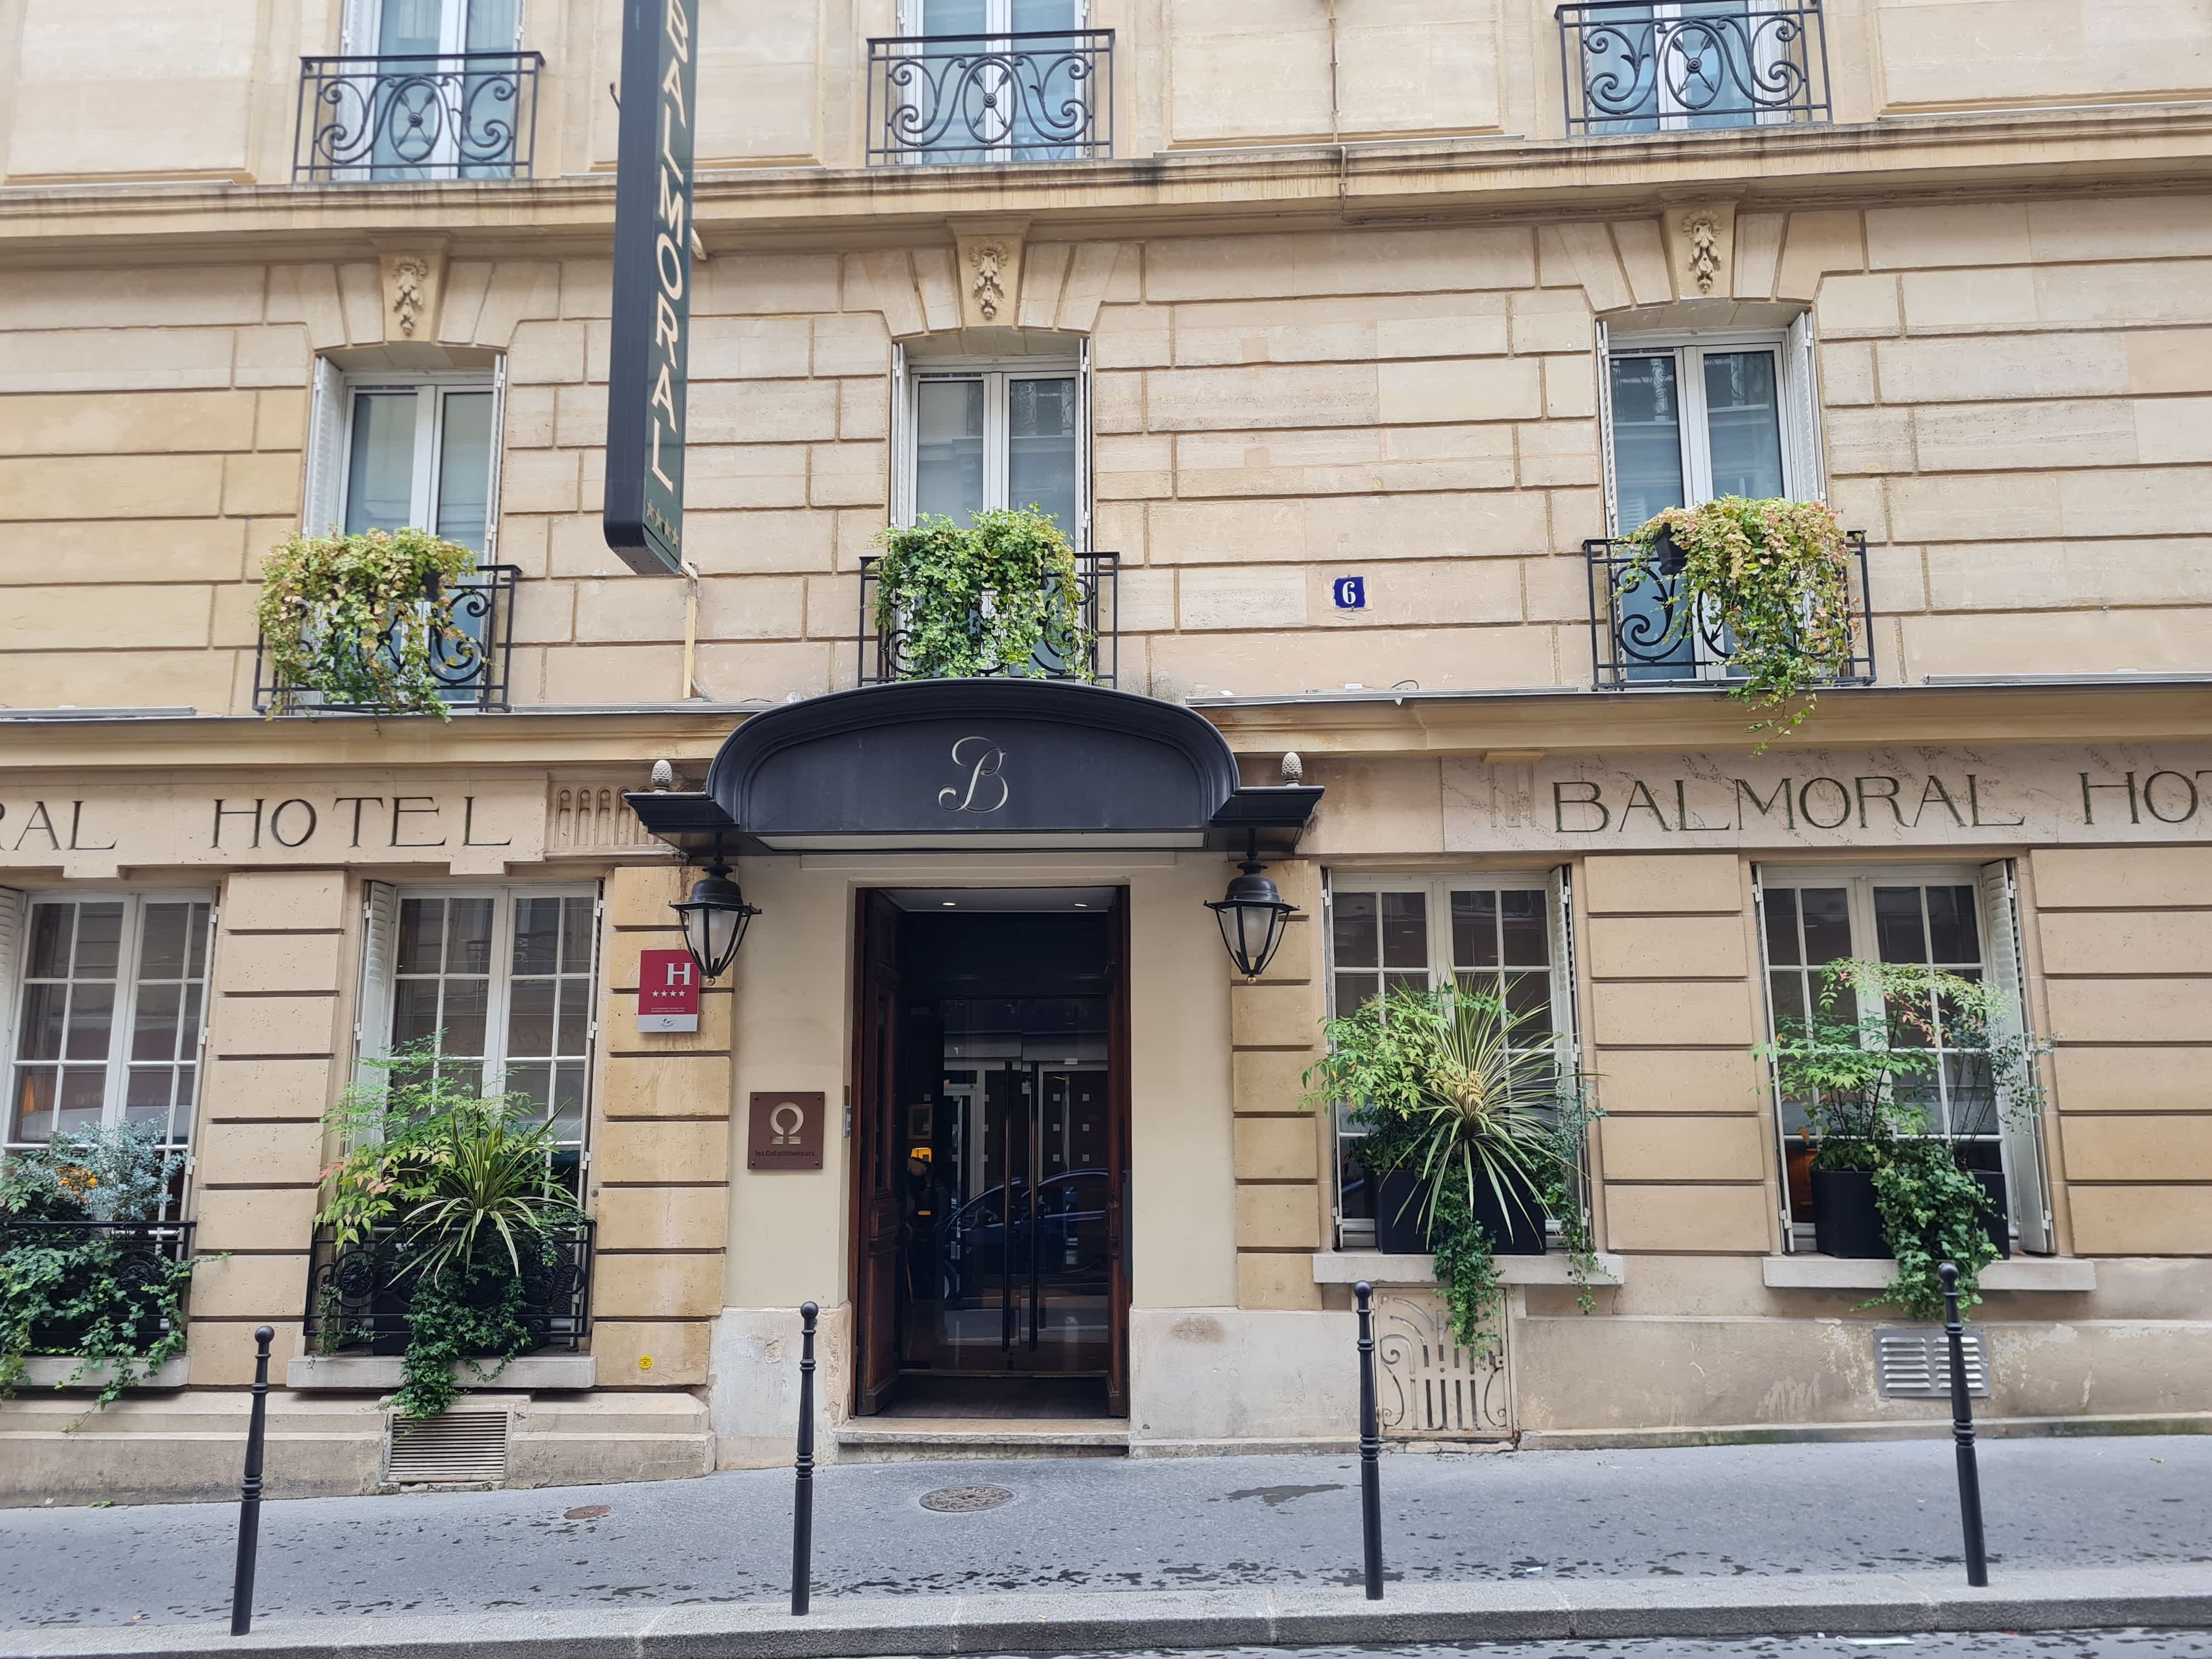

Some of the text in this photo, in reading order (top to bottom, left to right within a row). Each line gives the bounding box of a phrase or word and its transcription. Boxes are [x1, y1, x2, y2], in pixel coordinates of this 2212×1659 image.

[651, 0, 688, 495] BALMORAL
[1342, 581, 1356, 604] 6
[938, 736, 1008, 813] B
[0, 797, 513, 851] AL HOTEL
[1552, 775, 2025, 832] BALMORAL
[665, 963, 693, 986] H
